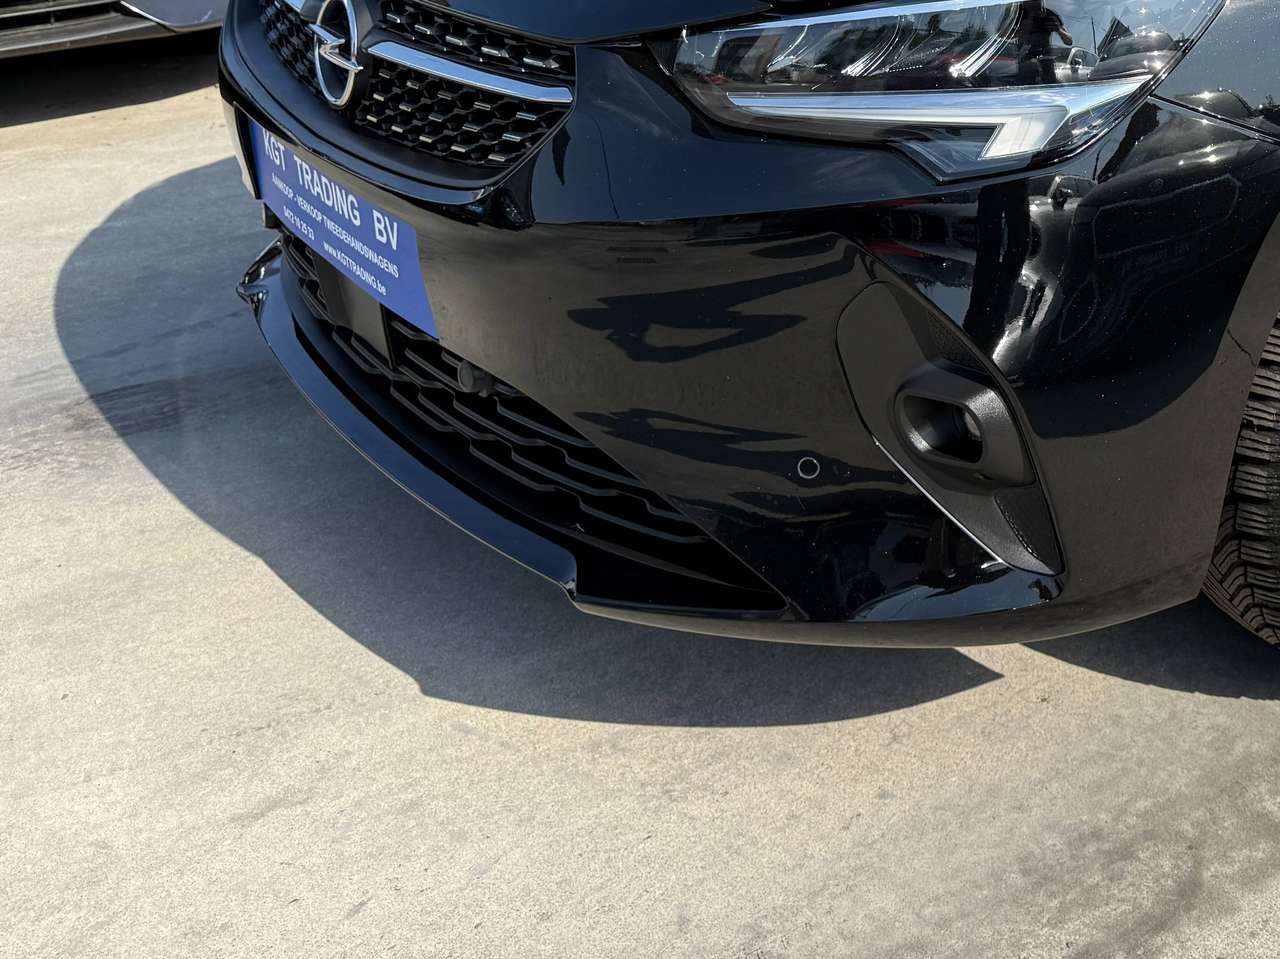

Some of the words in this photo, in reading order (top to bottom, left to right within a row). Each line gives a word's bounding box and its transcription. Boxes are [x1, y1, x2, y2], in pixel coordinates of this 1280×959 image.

[262, 127, 285, 172] KGT
[293, 154, 361, 227] TRADING
[372, 208, 398, 251] BV
[296, 193, 322, 223] VERKOOP
[322, 215, 399, 279] TWEEDEHANDSWAGENS
